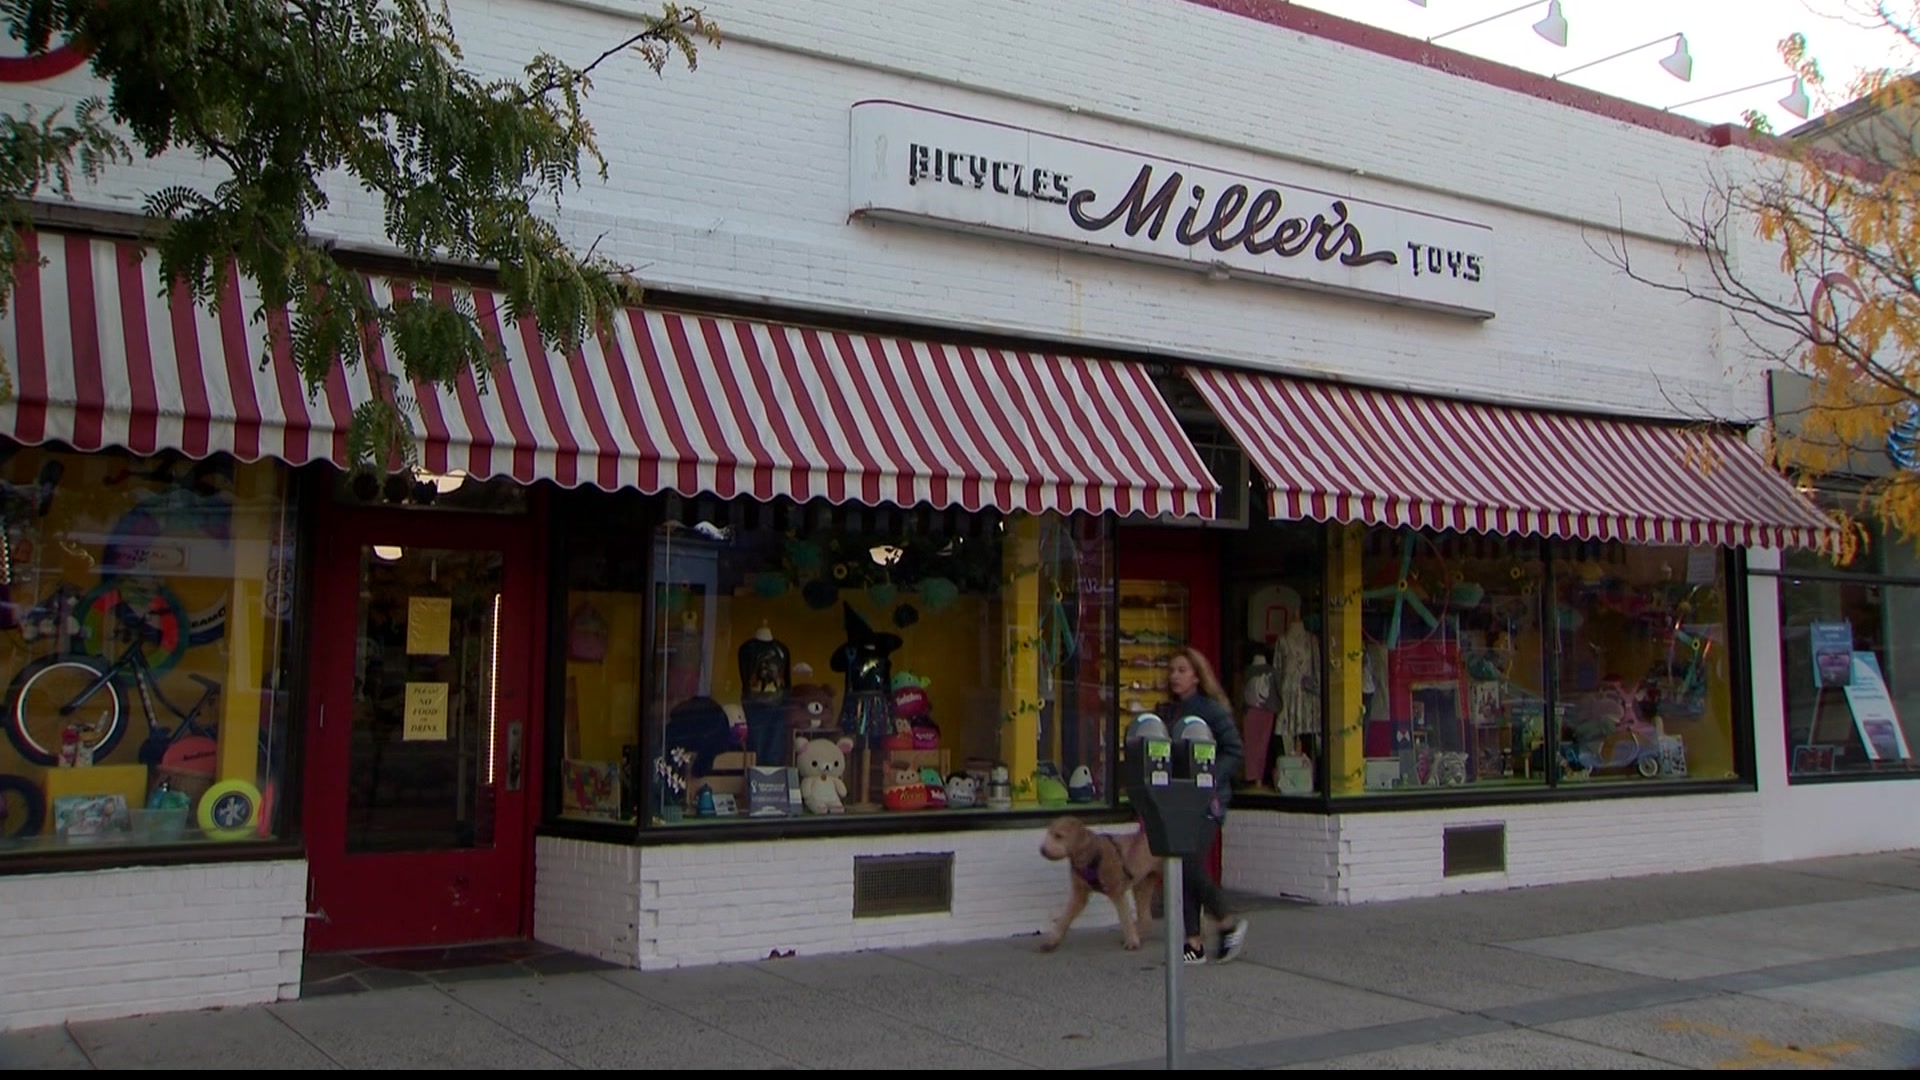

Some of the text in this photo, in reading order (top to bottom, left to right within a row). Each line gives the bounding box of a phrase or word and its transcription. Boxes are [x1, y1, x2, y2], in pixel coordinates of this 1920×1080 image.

[909, 143, 1070, 205] BICYCLES
[1068, 164, 1398, 267] Miller's
[1407, 241, 1483, 283] TOYS
[410, 724, 438, 732] DRINK
[412, 708, 438, 716] FOOD
